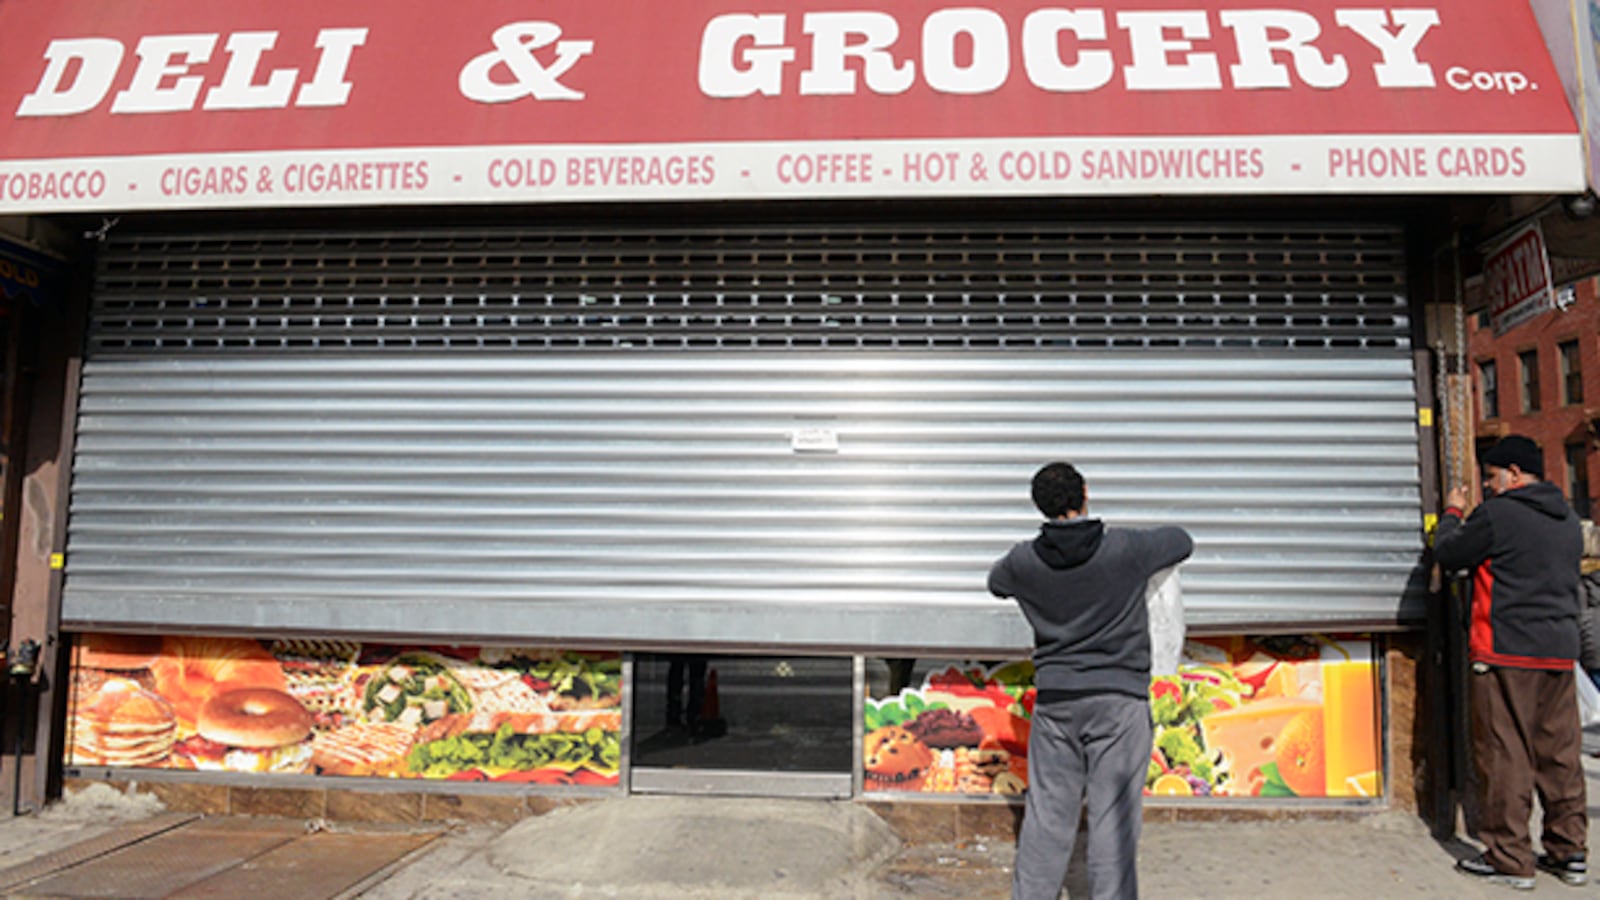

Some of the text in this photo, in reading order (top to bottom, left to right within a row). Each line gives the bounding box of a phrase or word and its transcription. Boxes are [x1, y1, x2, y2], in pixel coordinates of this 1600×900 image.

[16, 7, 1538, 117] DELI & GROCERY Corp.
[0, 170, 106, 200] TOBACCO
[161, 166, 247, 196] CIGARS
[256, 166, 272, 192] &
[284, 161, 428, 192] CIGARETTES
[488, 159, 556, 187] COLD
[567, 156, 714, 186] BEVERAGES
[777, 154, 872, 184] COFFEE
[904, 153, 959, 182] HOT
[970, 153, 987, 181] &
[999, 151, 1072, 180] COLD
[1082, 149, 1264, 180] SANDWICHES
[1329, 148, 1427, 177] PHONE
[1437, 147, 1525, 176] CARDS
